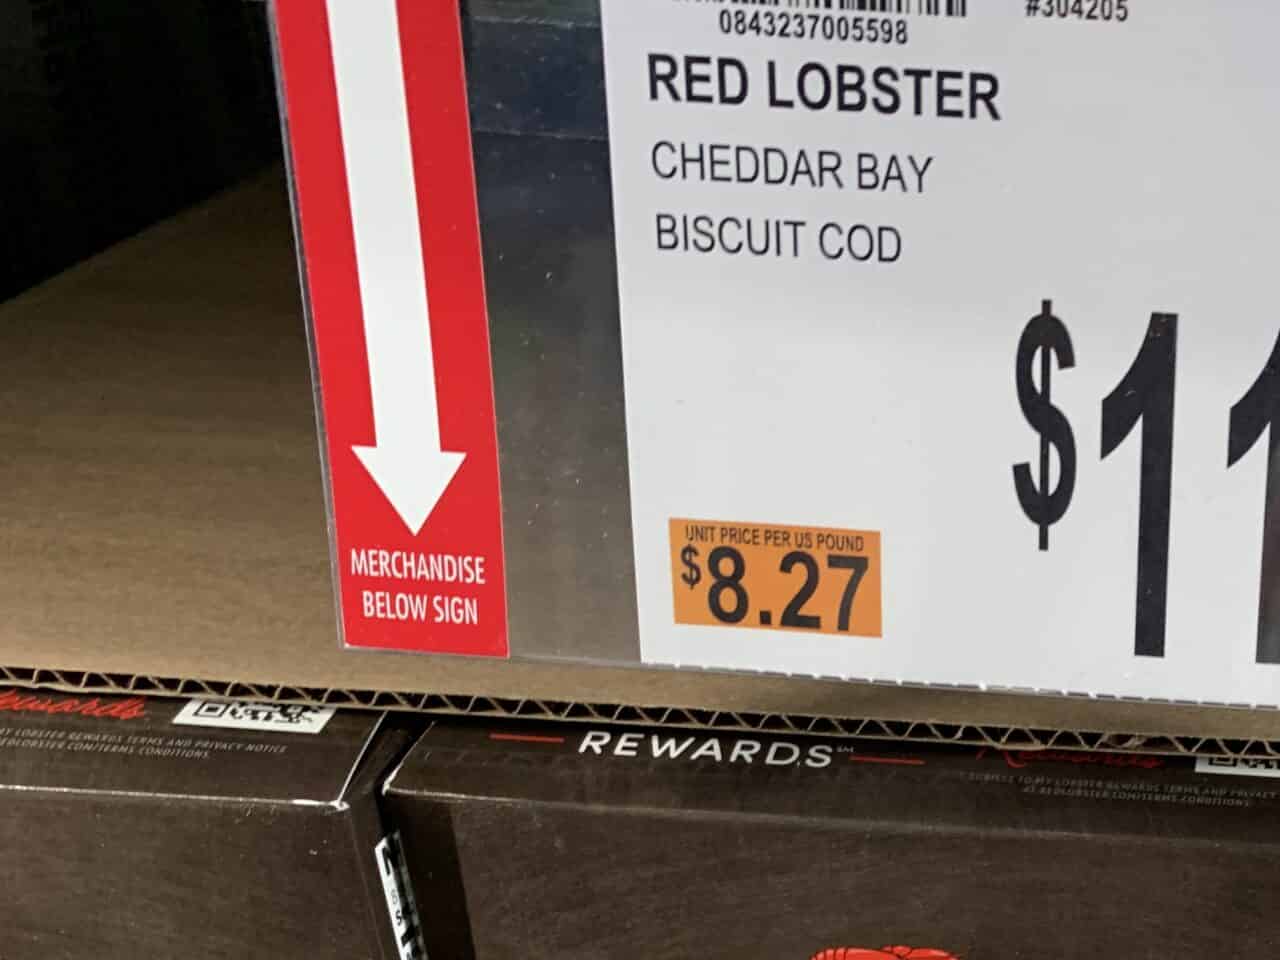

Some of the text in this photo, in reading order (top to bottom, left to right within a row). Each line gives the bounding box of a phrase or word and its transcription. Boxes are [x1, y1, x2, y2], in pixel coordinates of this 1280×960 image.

[719, 10, 908, 44] 0843237005598
[1025, 0, 1130, 22] #304205
[648, 53, 1001, 121] RED LOBSTER
[651, 140, 934, 194] CHEDDAR BAY
[655, 213, 902, 263] BISCUIT COD
[684, 525, 865, 552] UNIT PRICE PER US POUND
[350, 548, 487, 586] MERCHANDISE
[680, 546, 869, 633] $8.27
[361, 591, 479, 626] BELOW SIGN
[578, 731, 833, 768] REWARDS
